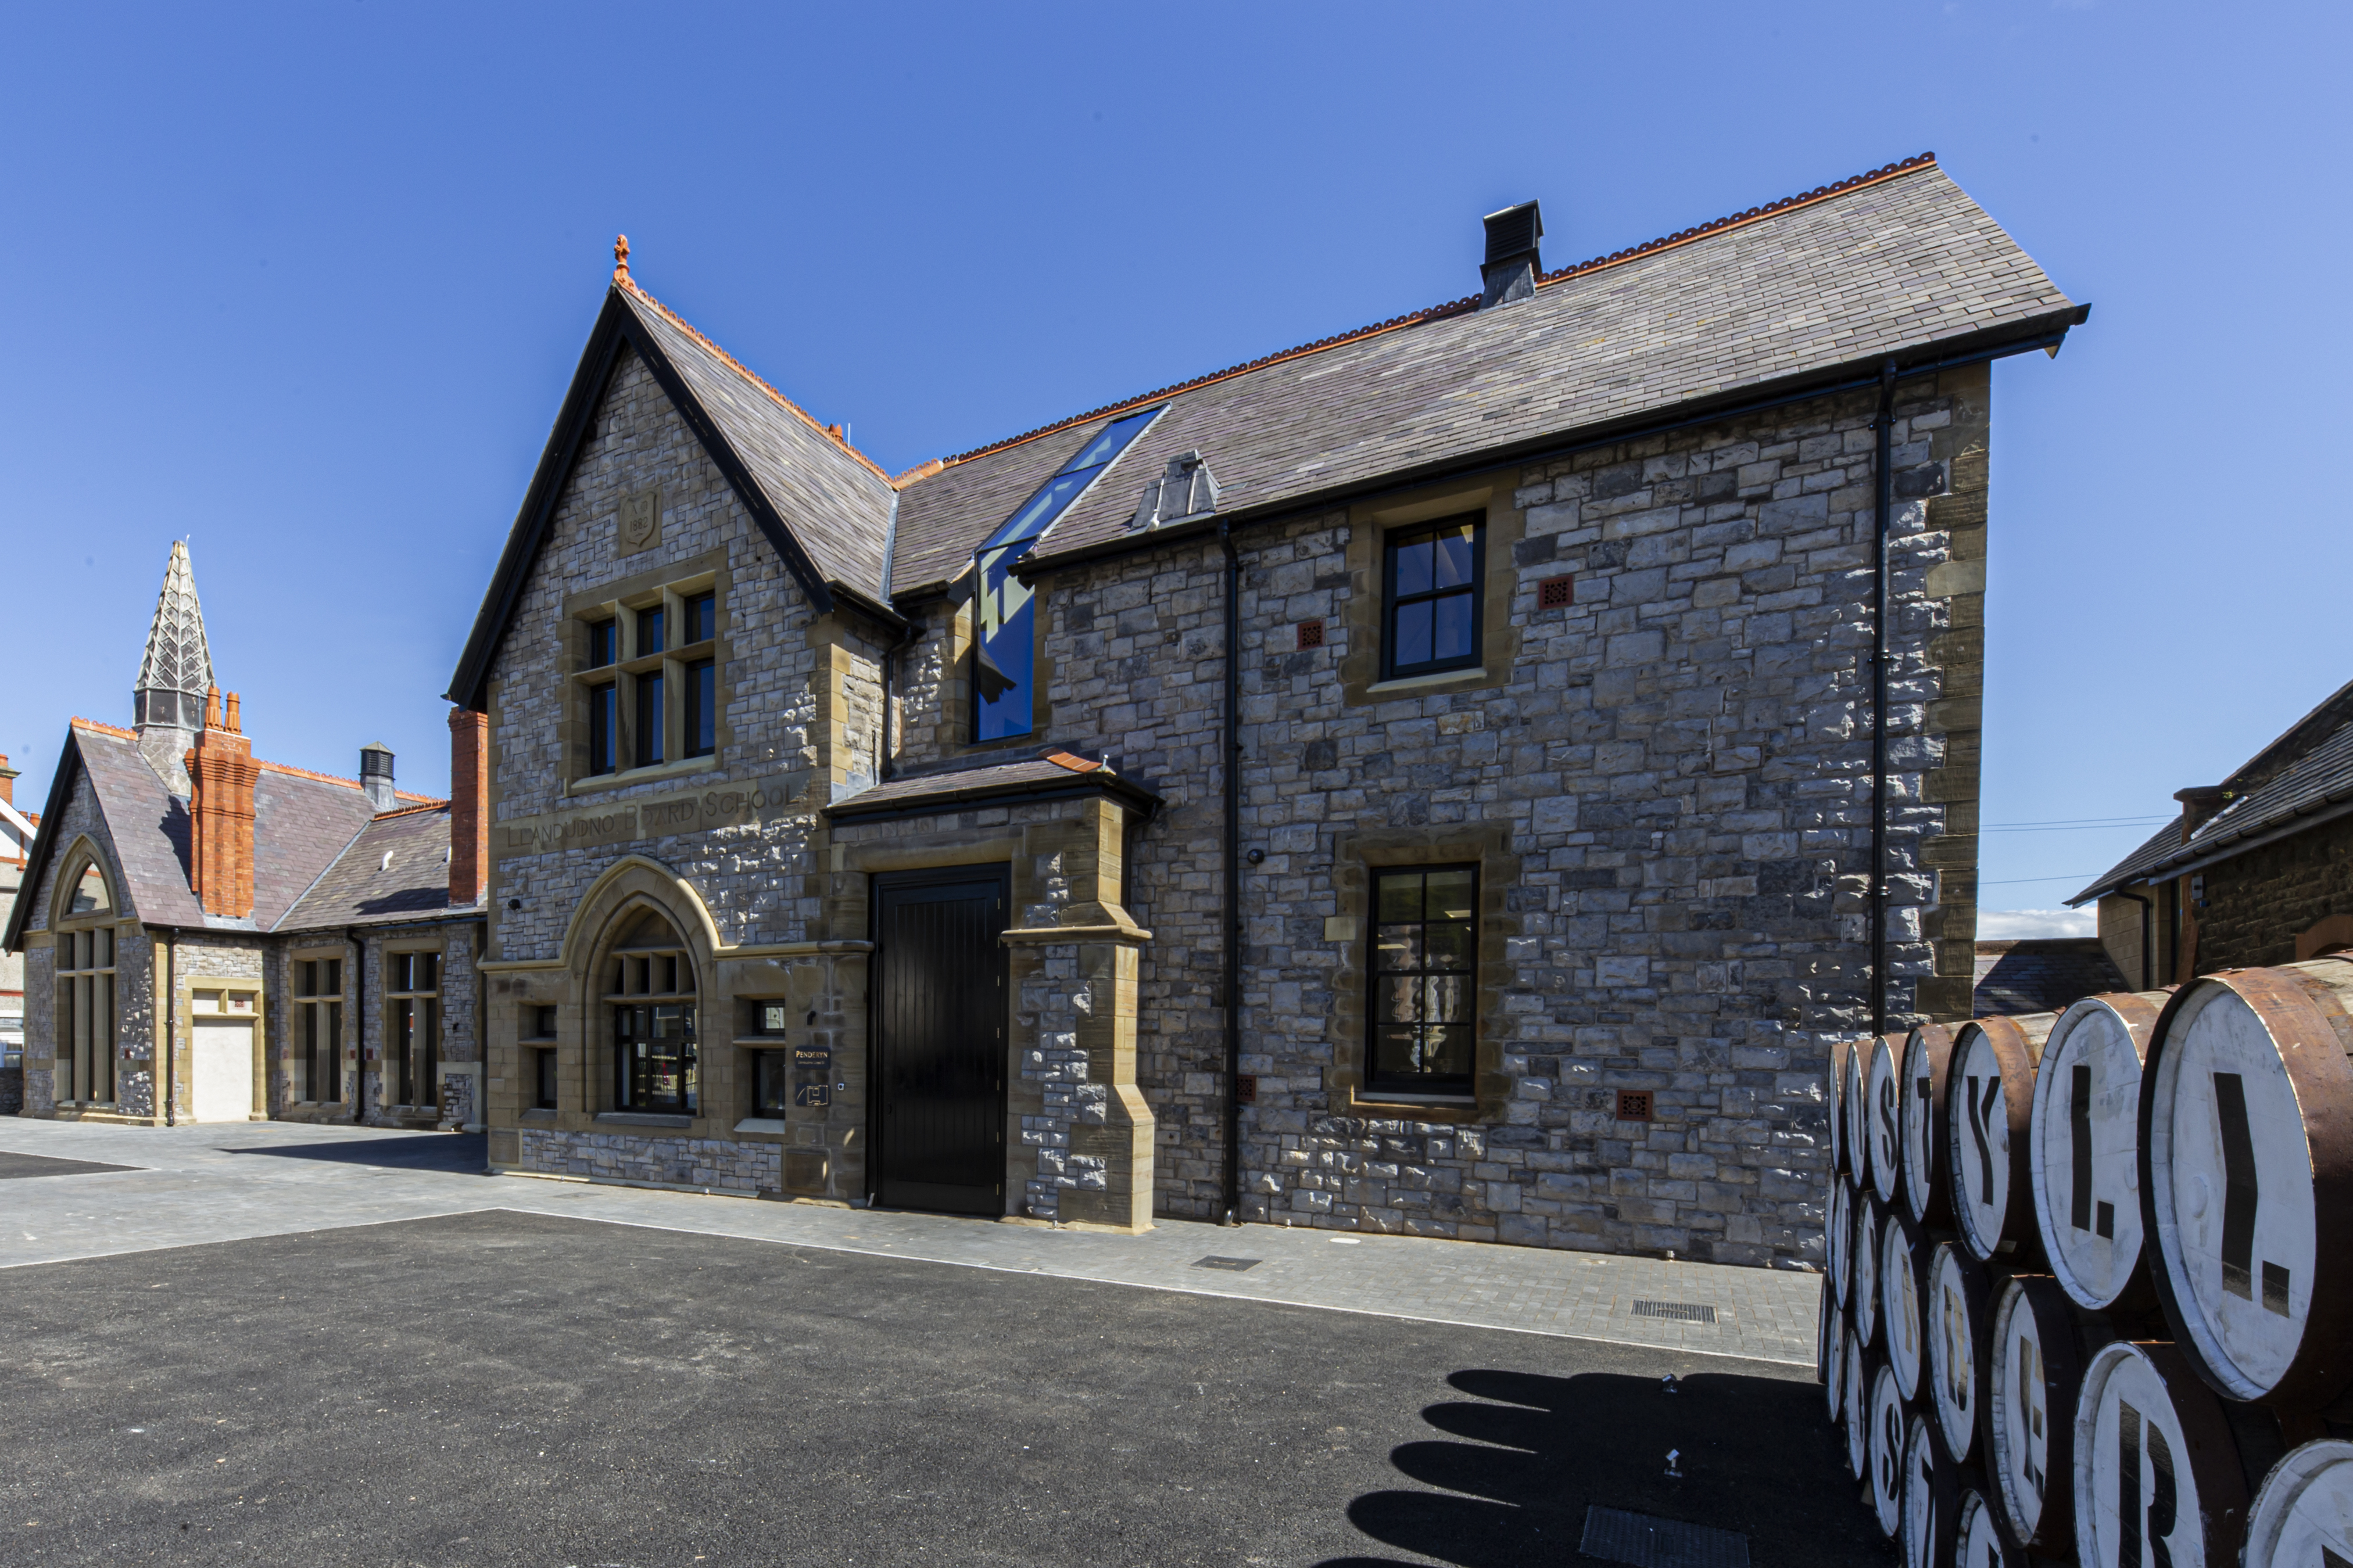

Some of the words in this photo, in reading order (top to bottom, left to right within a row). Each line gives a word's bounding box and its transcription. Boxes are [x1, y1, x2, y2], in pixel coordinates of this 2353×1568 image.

[630, 516, 648, 532] 1882
[507, 816, 615, 848] LLANDUDNO
[625, 803, 694, 830] BOARD
[705, 784, 799, 817] SCHOOL
